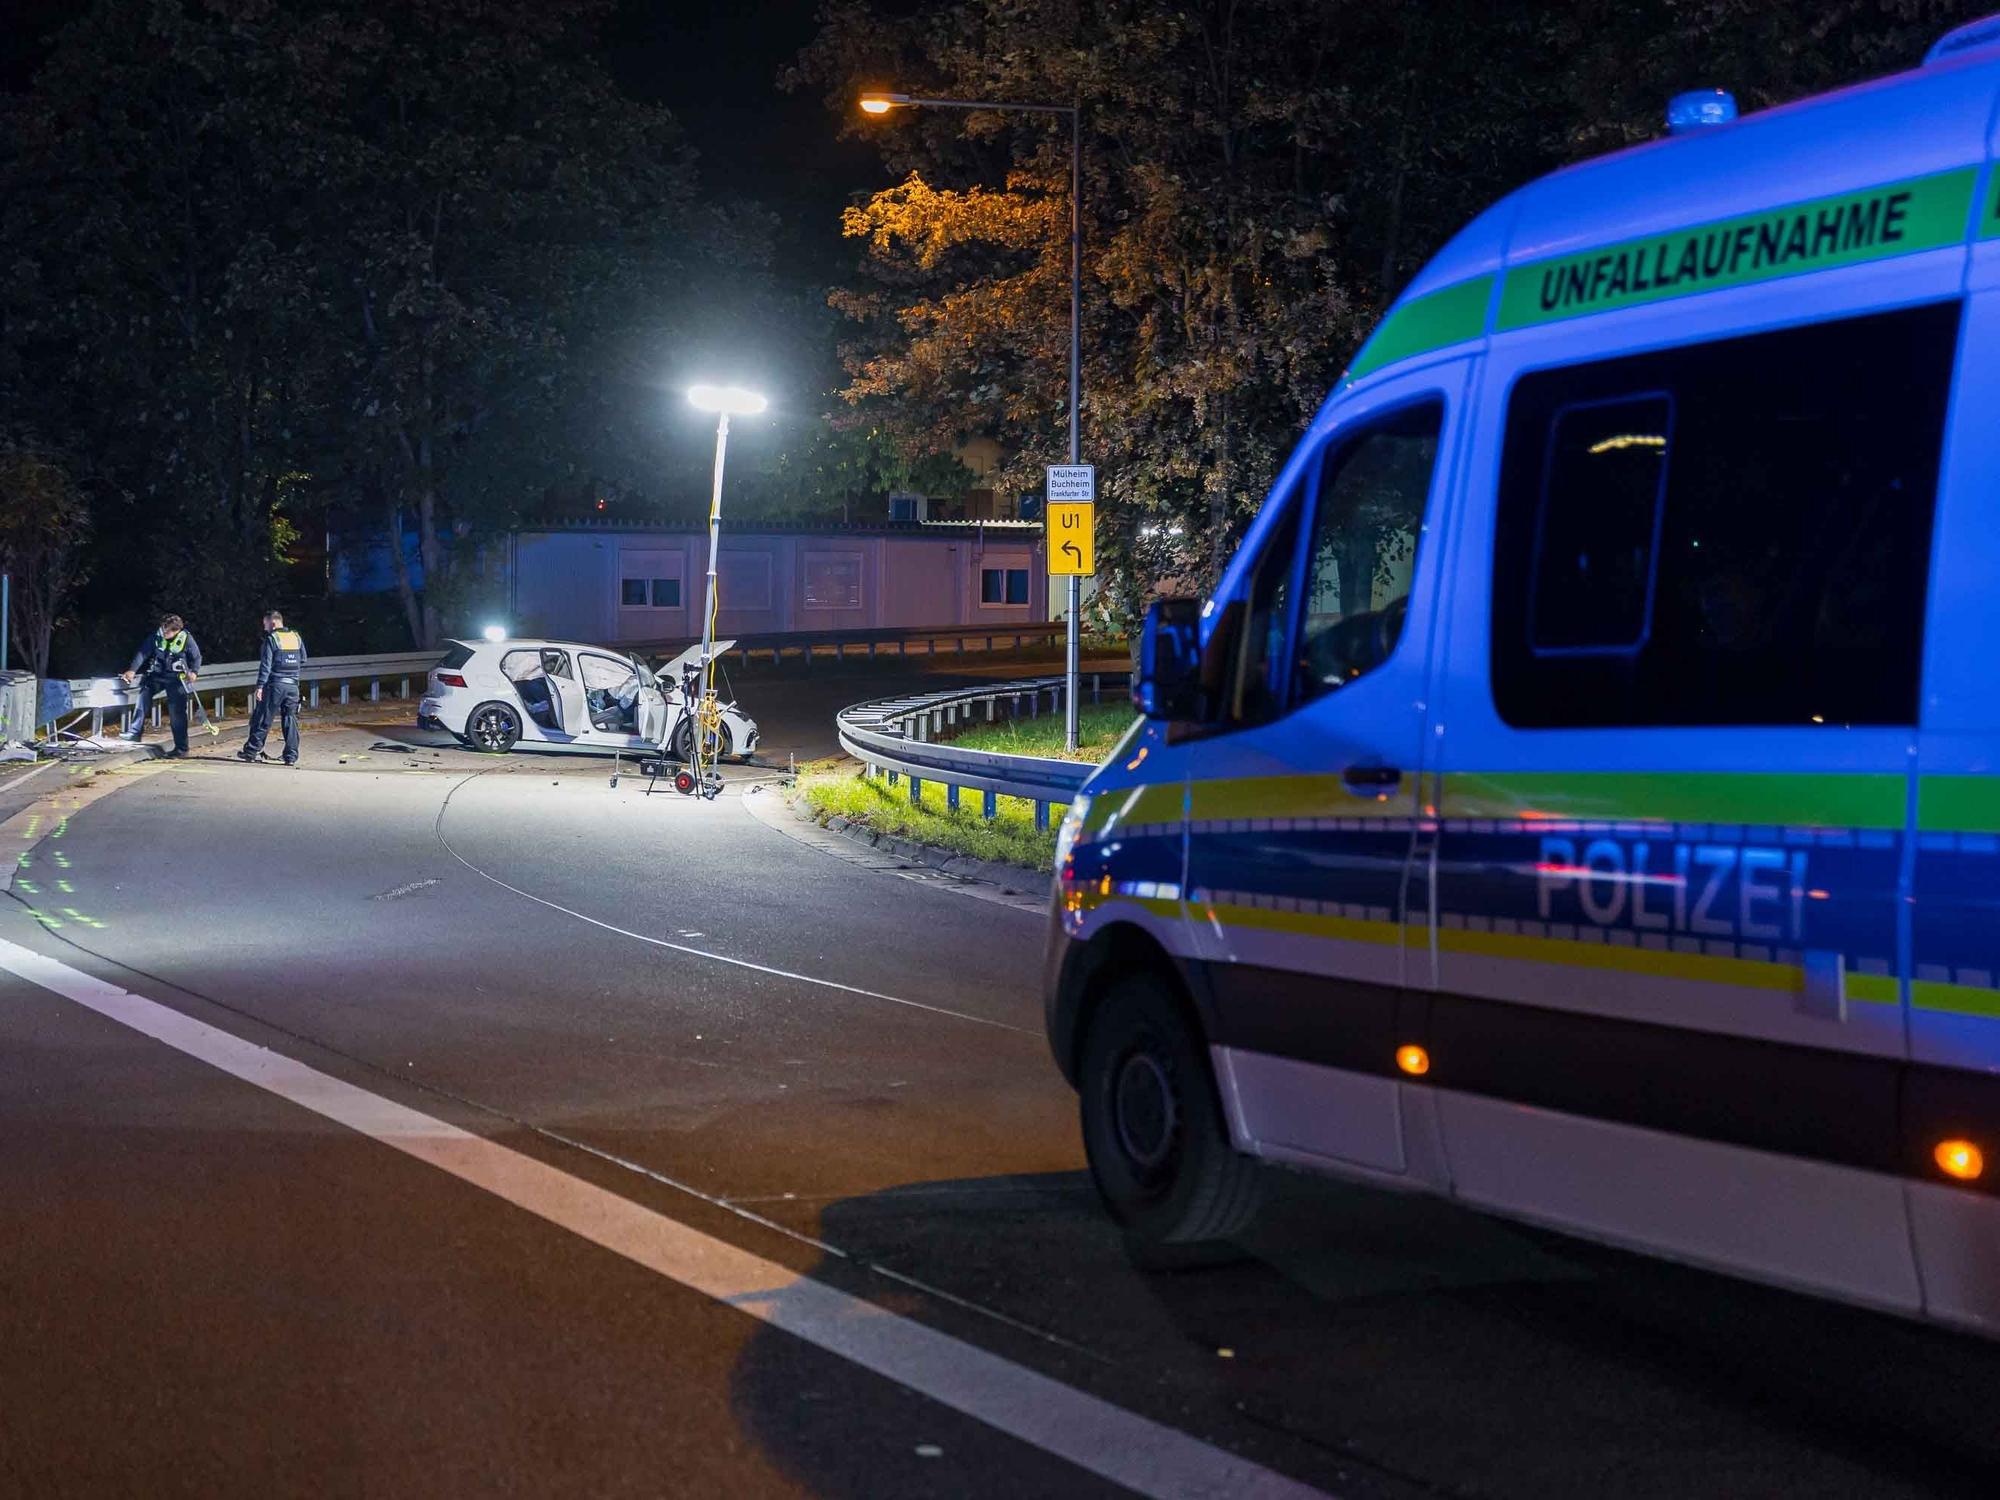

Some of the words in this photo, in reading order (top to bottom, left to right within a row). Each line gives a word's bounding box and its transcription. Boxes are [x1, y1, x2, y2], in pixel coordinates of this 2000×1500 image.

[1540, 192, 1912, 311] UNFALLAUFNAHME
[1053, 470, 1088, 478] Mülheim
[1051, 480, 1090, 488] Buchheim
[1062, 513, 1080, 529] U1
[1537, 837, 1808, 942] POLIZEI
